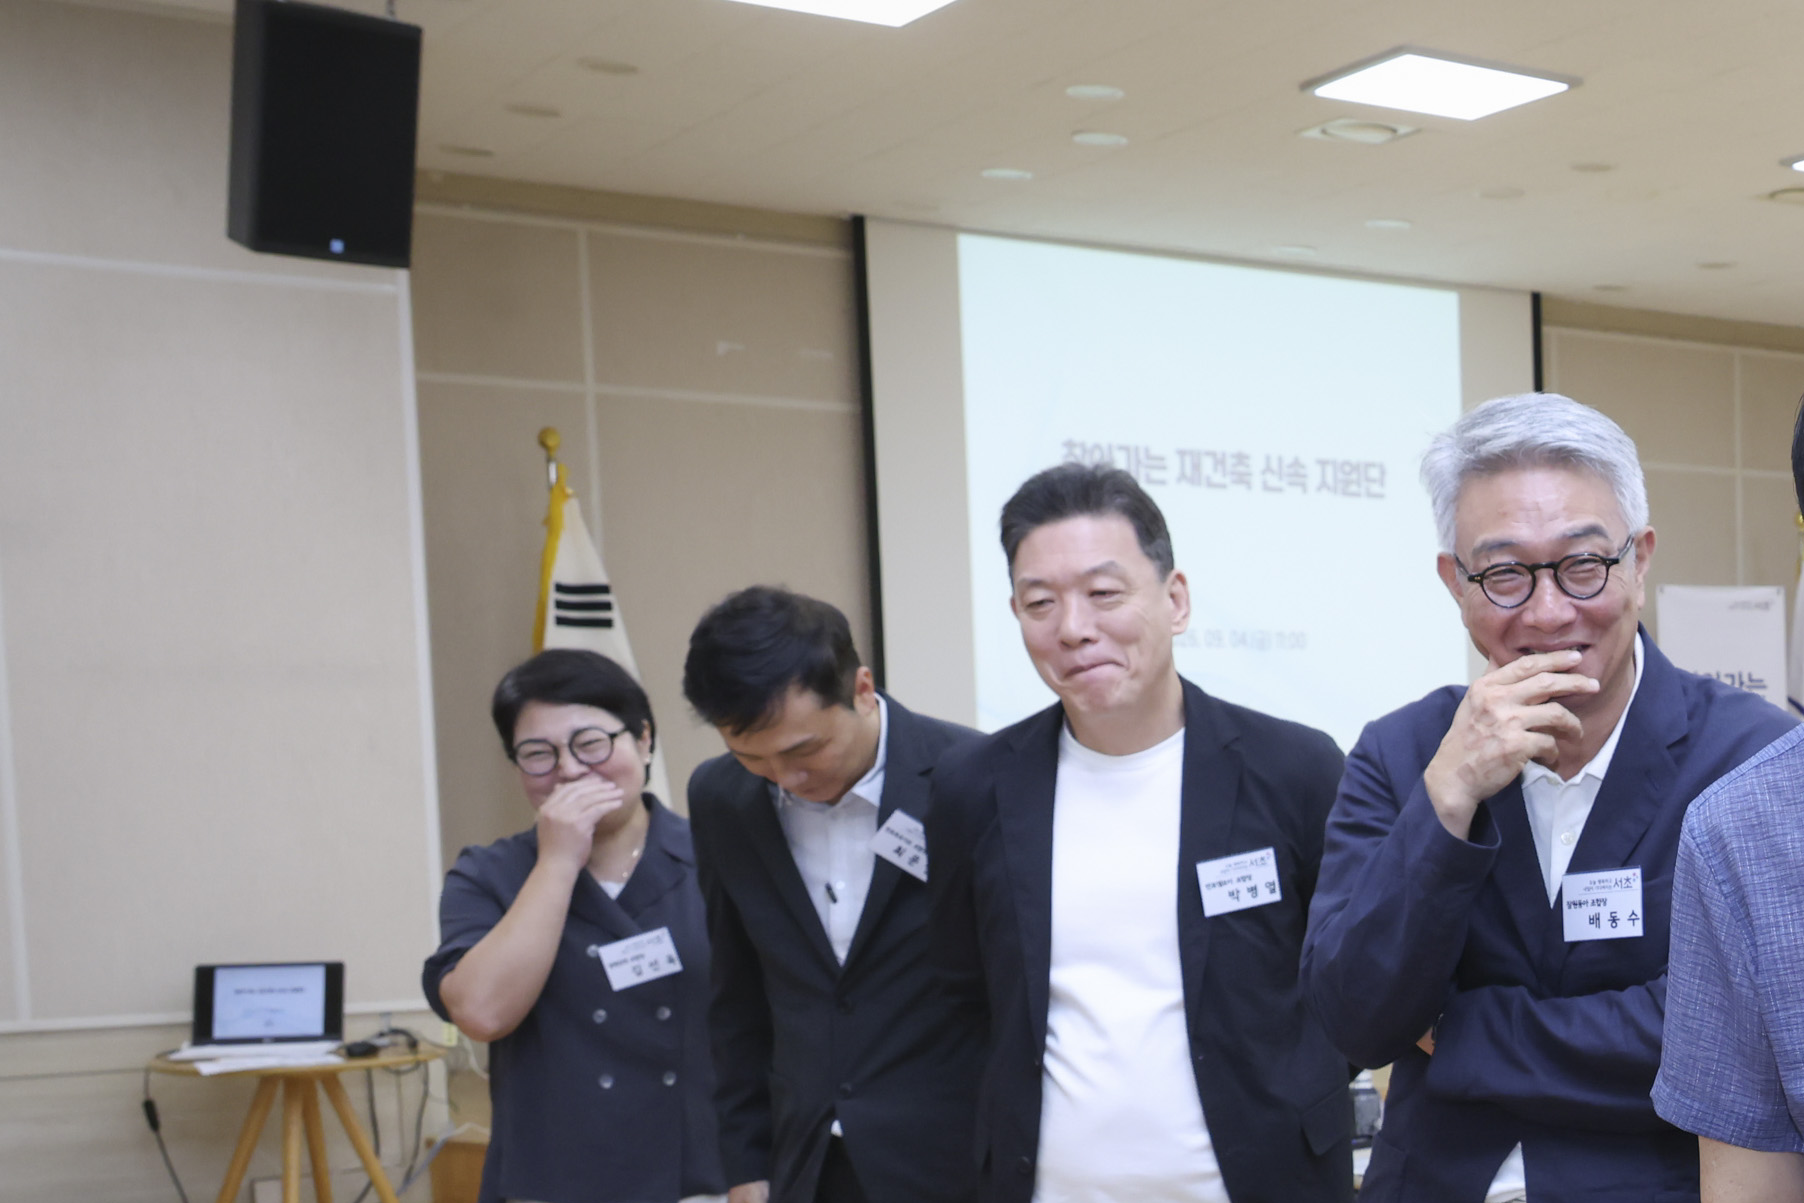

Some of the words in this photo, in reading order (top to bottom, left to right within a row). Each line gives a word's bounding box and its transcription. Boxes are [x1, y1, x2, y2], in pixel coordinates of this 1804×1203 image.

[1176, 448, 1252, 491] 재건축
[1261, 453, 1308, 494] 신속
[1315, 458, 1386, 499] 지원단
[1613, 876, 1633, 889] 서초
